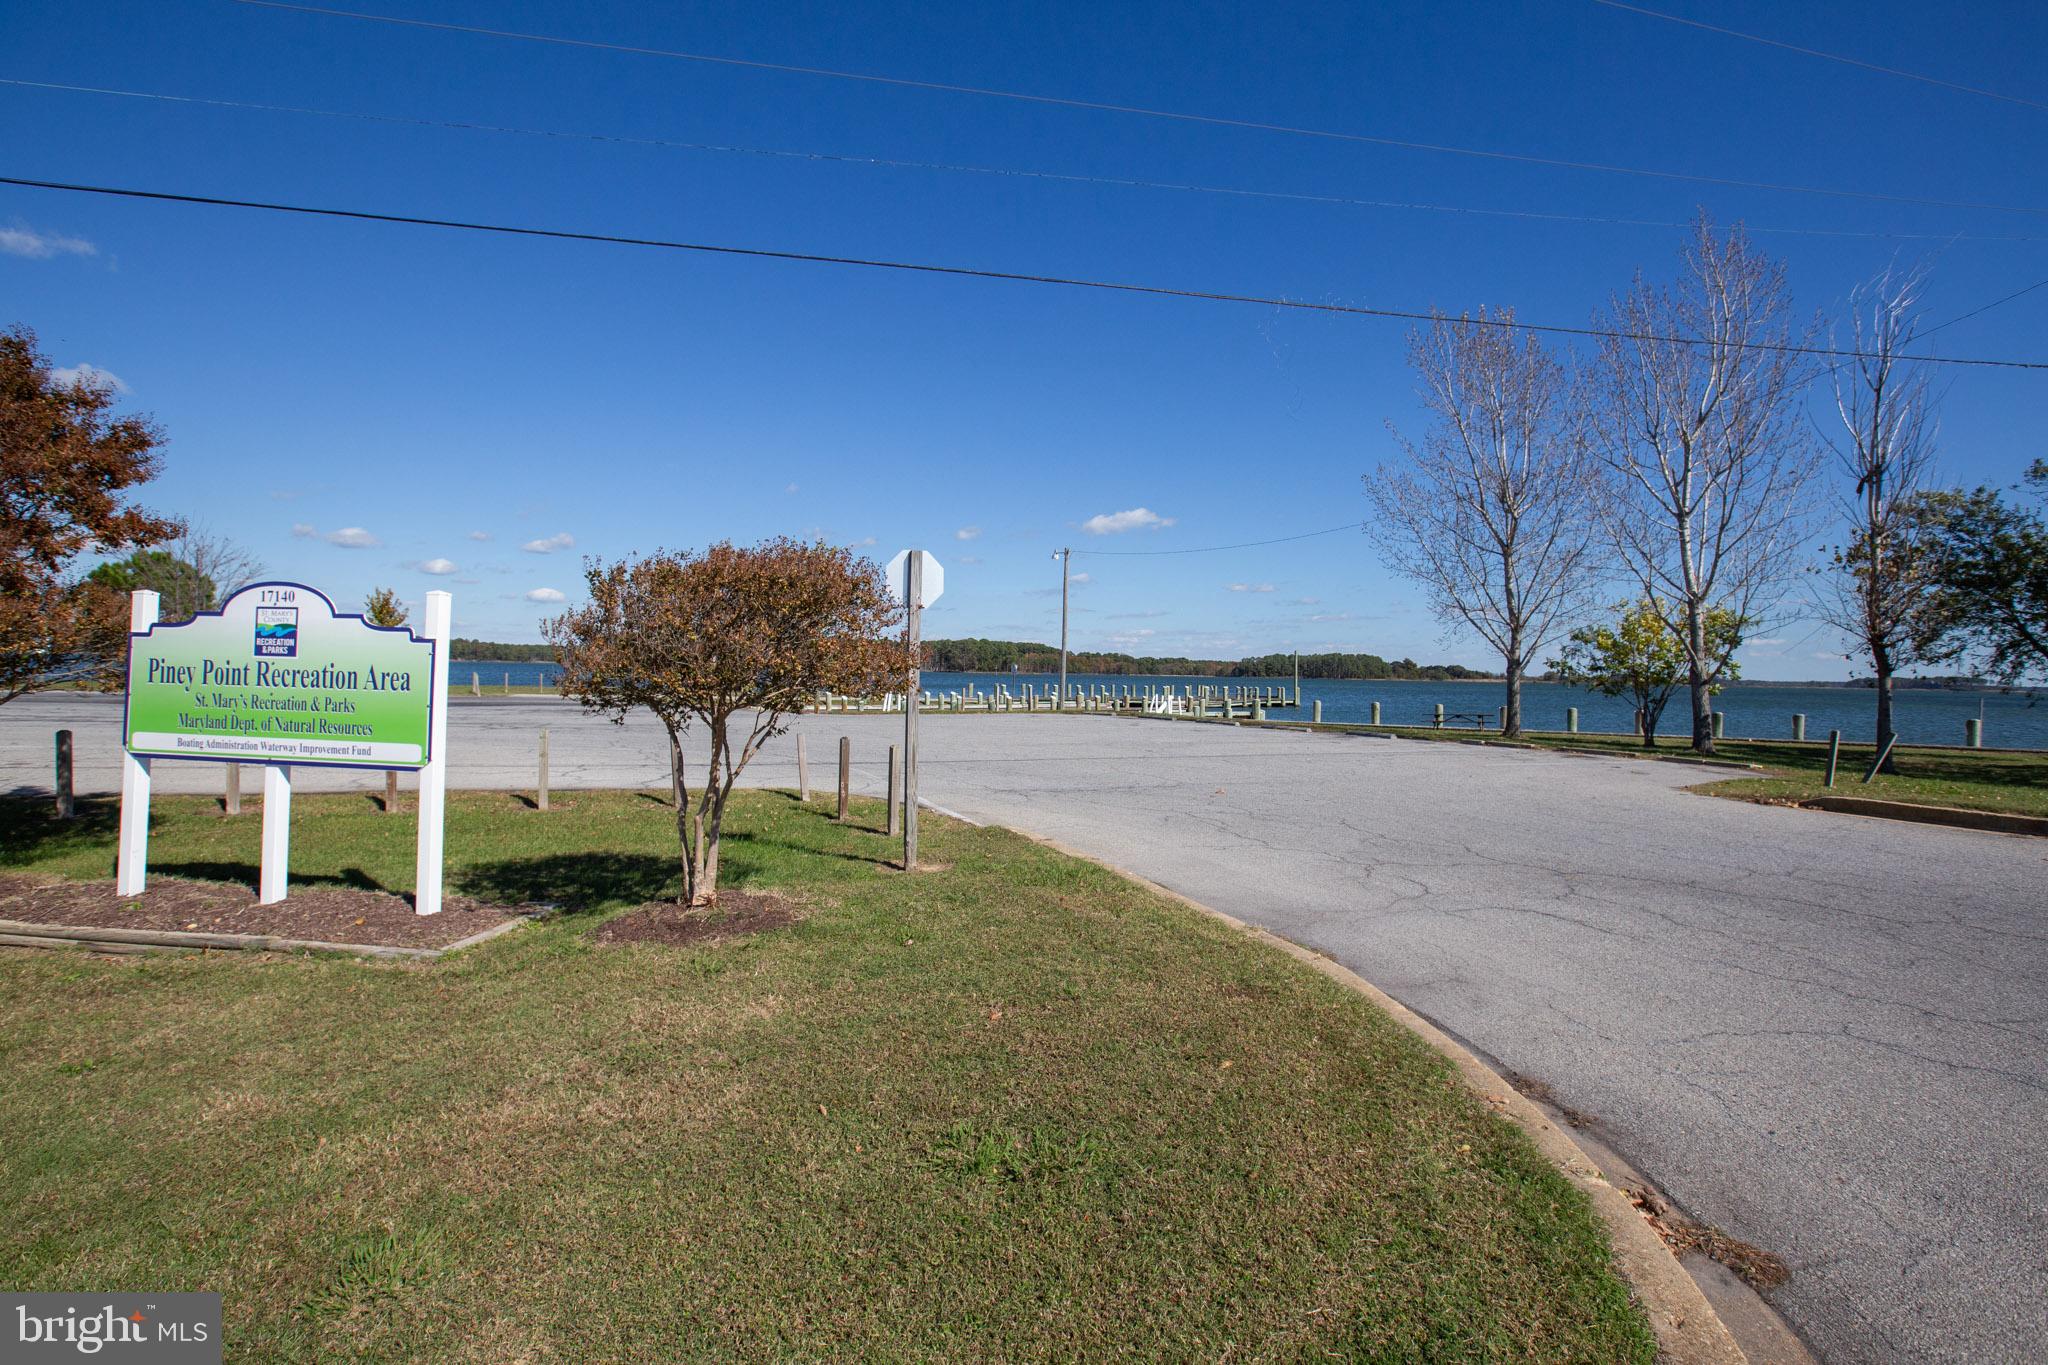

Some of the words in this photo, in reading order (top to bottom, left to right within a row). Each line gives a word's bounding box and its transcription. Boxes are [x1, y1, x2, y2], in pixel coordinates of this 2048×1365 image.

[261, 590, 295, 602] 17140
[256, 637, 295, 647] RECREATION
[147, 658, 196, 692] Piney
[202, 659, 250, 686] Point
[256, 660, 358, 690] Recreation
[363, 664, 411, 692] Area
[195, 692, 208, 708] St.
[212, 693, 248, 712] Mary's
[251, 694, 307, 712] Recreation
[310, 696, 320, 712] &
[324, 697, 355, 713] Parks
[177, 712, 227, 732] Maryland
[231, 714, 258, 734] Dept.
[261, 715, 273, 732] of
[274, 716, 315, 733] Natural
[318, 718, 373, 736] Resources
[177, 737, 204, 749] Boating
[206, 739, 258, 751] Administration
[260, 741, 297, 754] Waterway
[300, 743, 350, 756] Improvement
[352, 745, 372, 756] Fund
